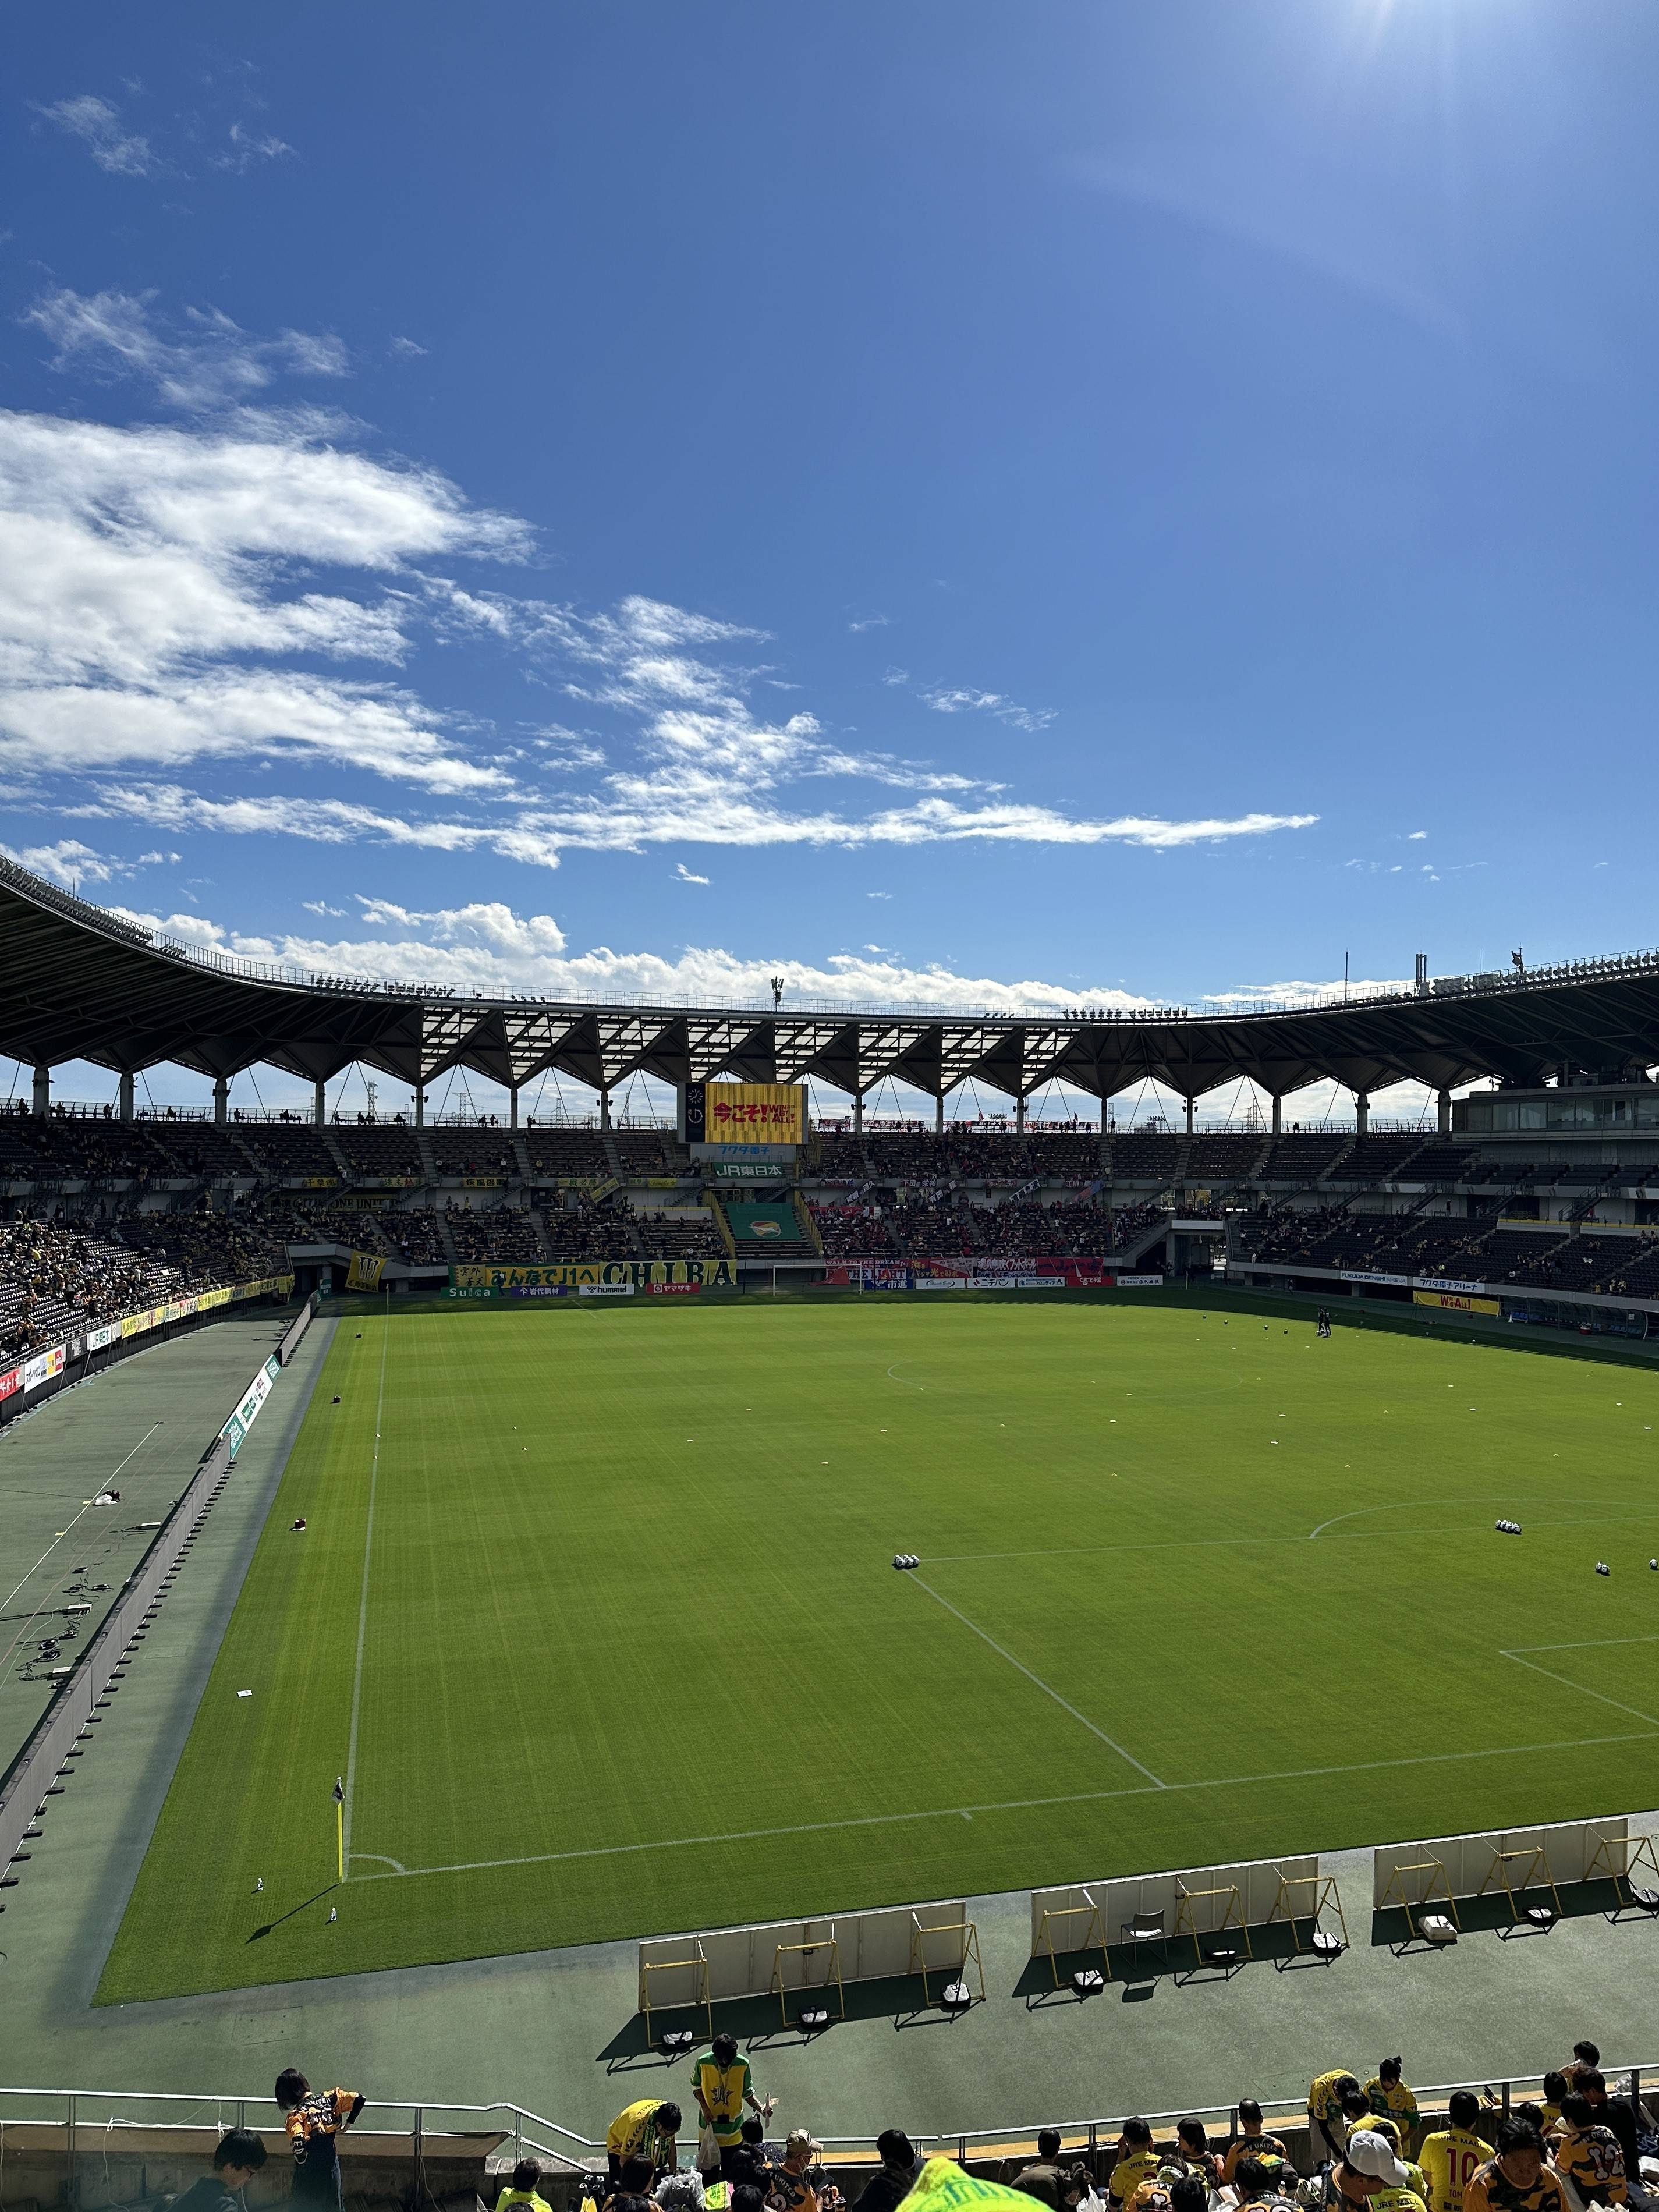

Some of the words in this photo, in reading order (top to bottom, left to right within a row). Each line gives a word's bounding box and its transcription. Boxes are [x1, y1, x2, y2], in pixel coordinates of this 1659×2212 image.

[716, 1165, 782, 1176] JR東日本
[492, 1268, 595, 1286] みんなでJ1へ
[602, 1261, 738, 1287] CHIBA
[888, 1281, 908, 1289] 市進
[449, 1288, 491, 1297] Suica
[1129, 2161, 1143, 2169] JRE
[1446, 2147, 1479, 2187] 10
[1377, 2200, 1394, 2209] JRE
